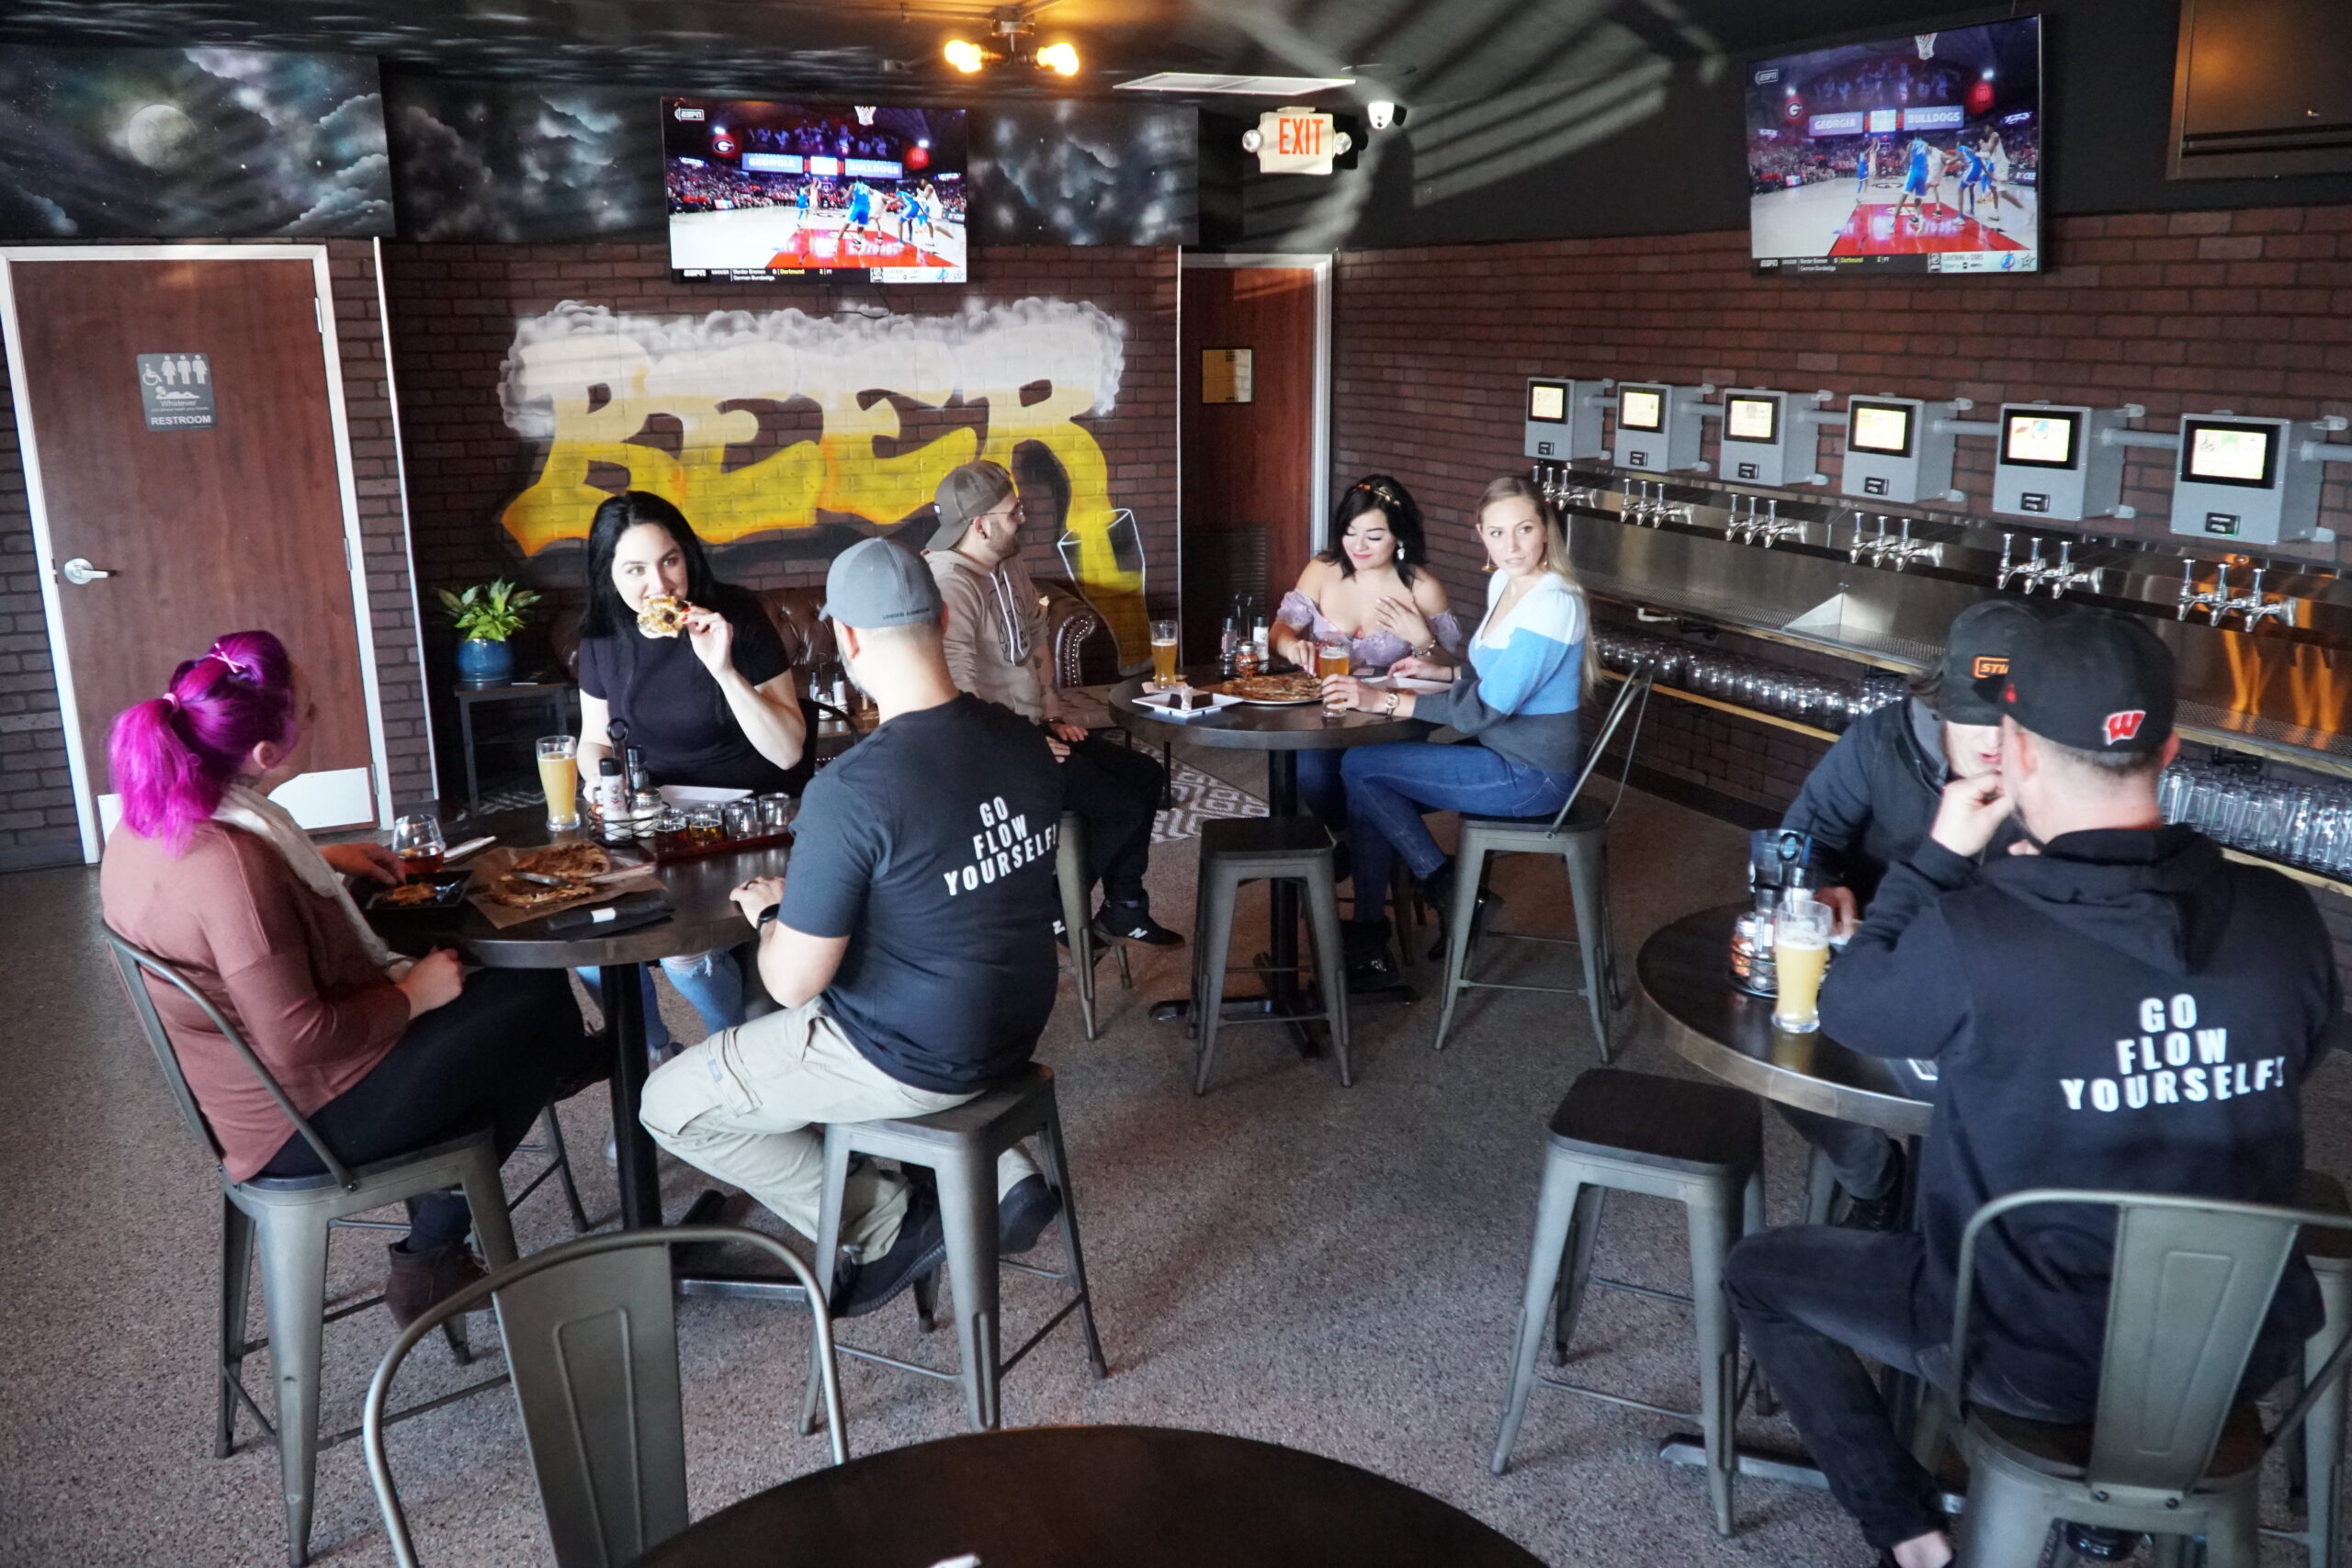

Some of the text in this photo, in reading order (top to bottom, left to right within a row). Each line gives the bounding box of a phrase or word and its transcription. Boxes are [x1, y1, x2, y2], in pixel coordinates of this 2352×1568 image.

[1278, 118, 1324, 155] EXIT
[1815, 111, 1961, 130] GEORGIA BULLDOGS
[748, 157, 899, 175] GEORGIA BULLDOGS
[683, 268, 707, 277] ESPN
[151, 415, 211, 425] RESTROOM
[501, 317, 1114, 557] BEER
[2102, 709, 2147, 746] W
[978, 795, 1009, 828] GO
[972, 814, 1028, 861] FLOW
[943, 823, 1057, 897] YOURSELF!
[2139, 993, 2198, 1033] GO
[2115, 1027, 2227, 1076] FLOW
[2059, 1055, 2285, 1112] YOURSELF!
